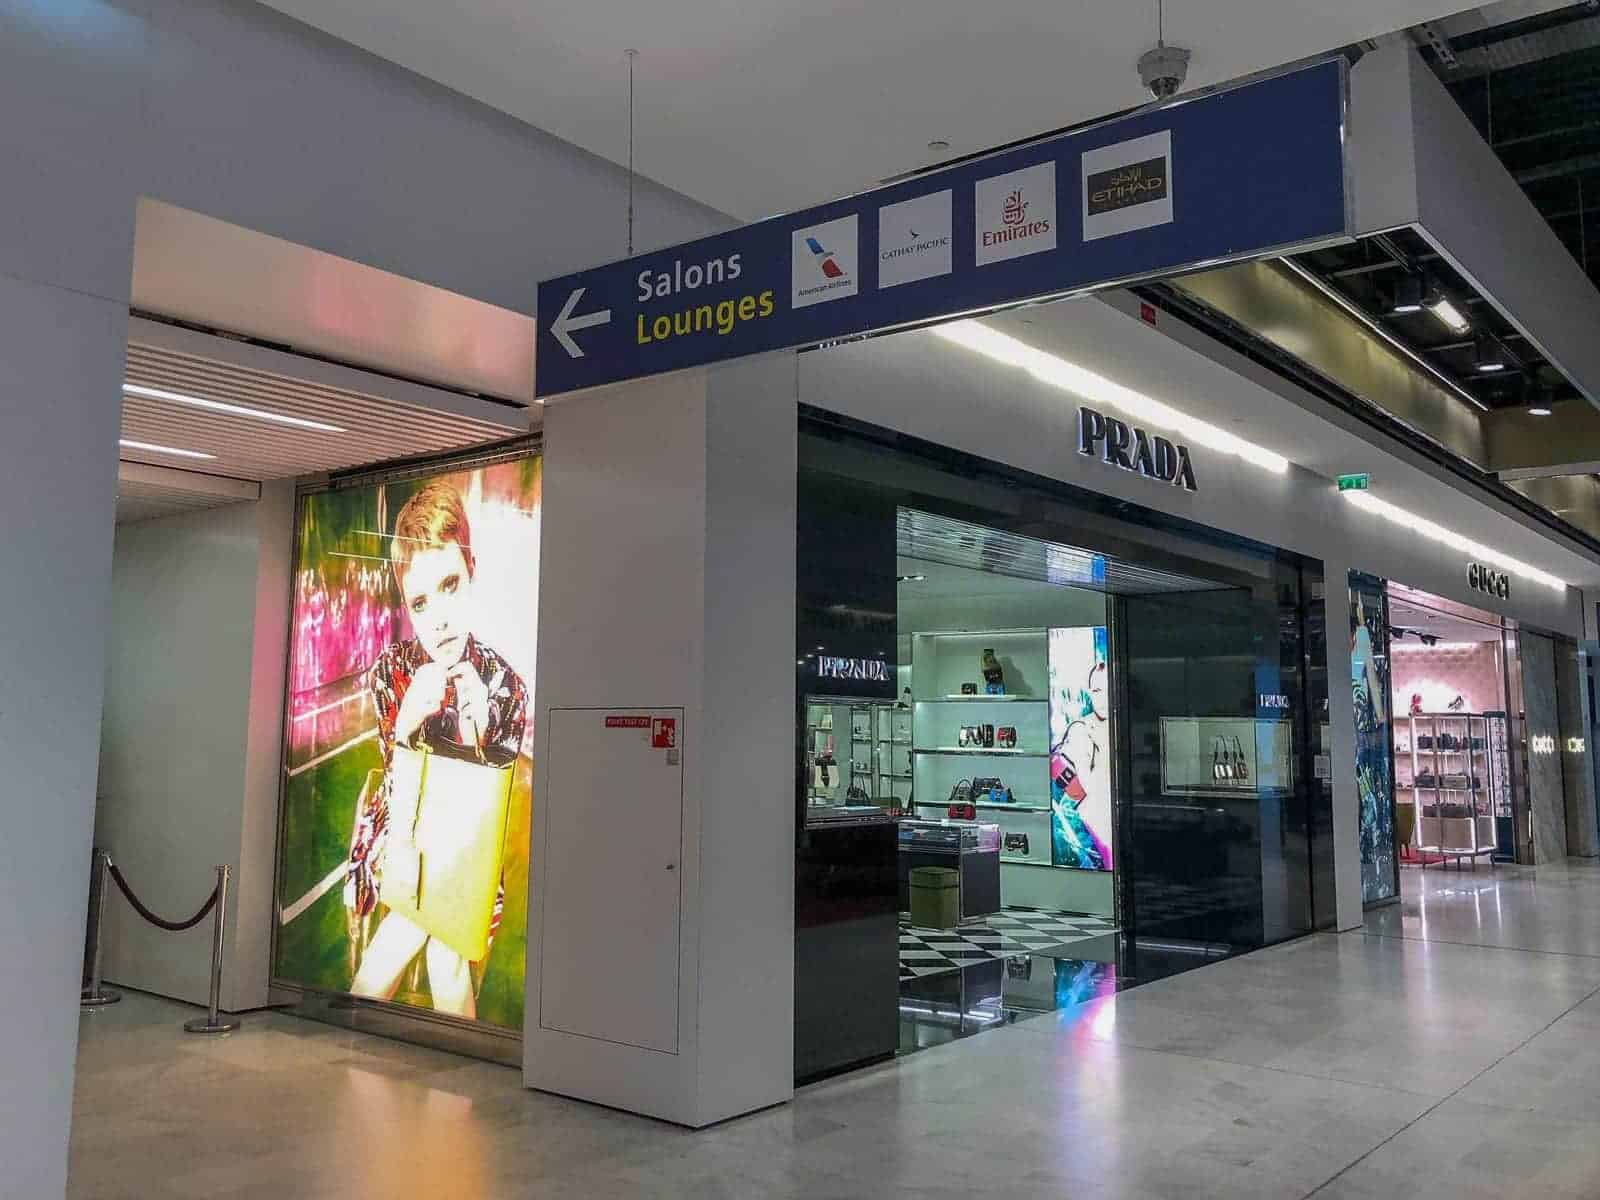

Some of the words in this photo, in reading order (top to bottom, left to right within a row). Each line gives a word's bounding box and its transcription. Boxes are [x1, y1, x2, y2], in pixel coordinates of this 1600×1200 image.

[1092, 177, 1162, 202] ETIHAD
[881, 246, 915, 260] CATHAY
[916, 237, 951, 251] PACIFIC
[983, 220, 1049, 247] Emirates
[638, 254, 742, 302] Salons
[637, 290, 775, 345] Lounges
[1077, 406, 1198, 492] PRADA
[1468, 563, 1510, 600] GUCCI
